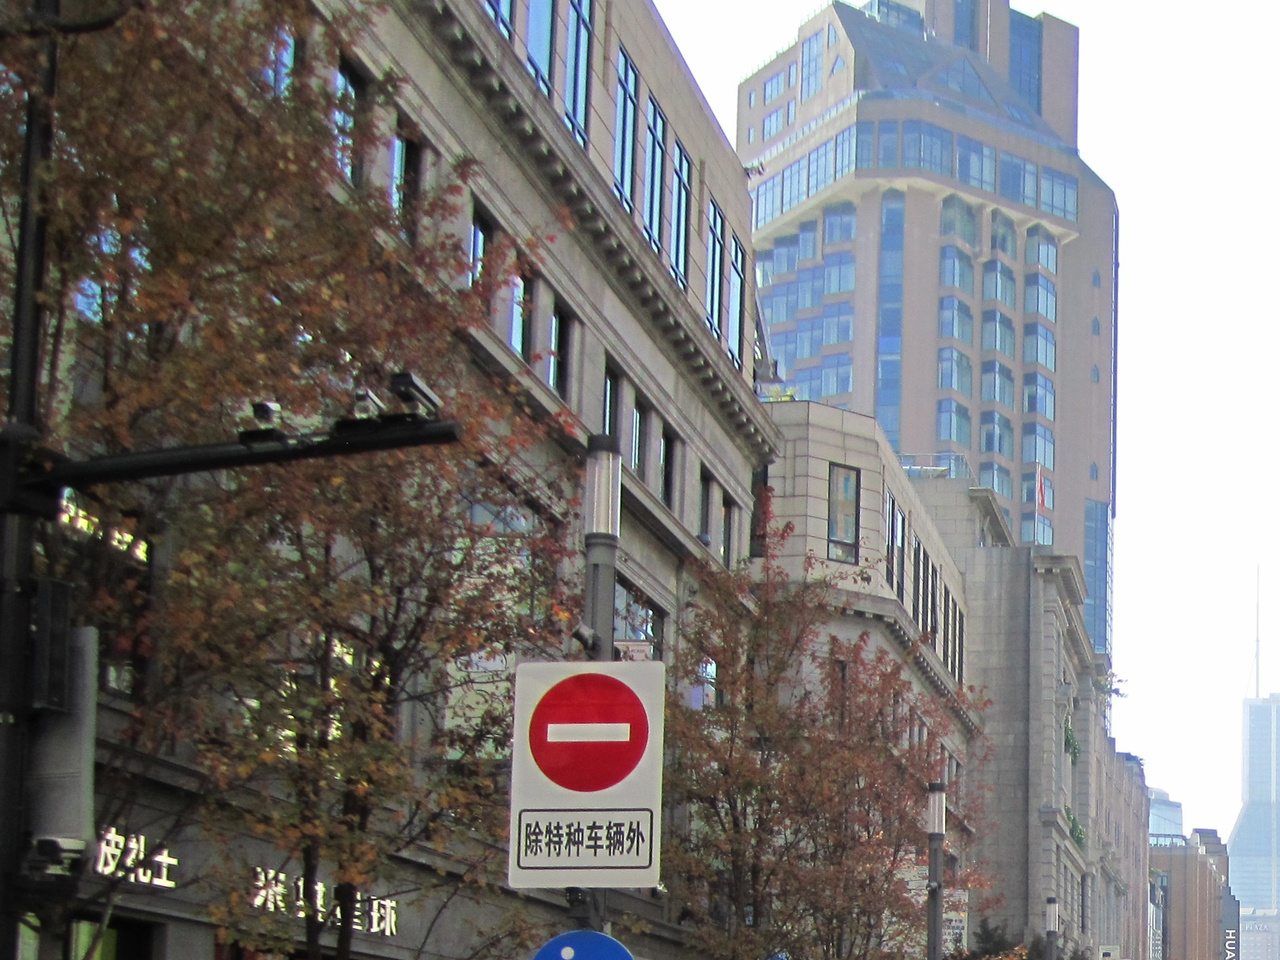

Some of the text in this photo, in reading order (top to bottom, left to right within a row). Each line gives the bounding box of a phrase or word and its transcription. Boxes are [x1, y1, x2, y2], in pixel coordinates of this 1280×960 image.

[524, 820, 646, 858] 除特种车辆外
